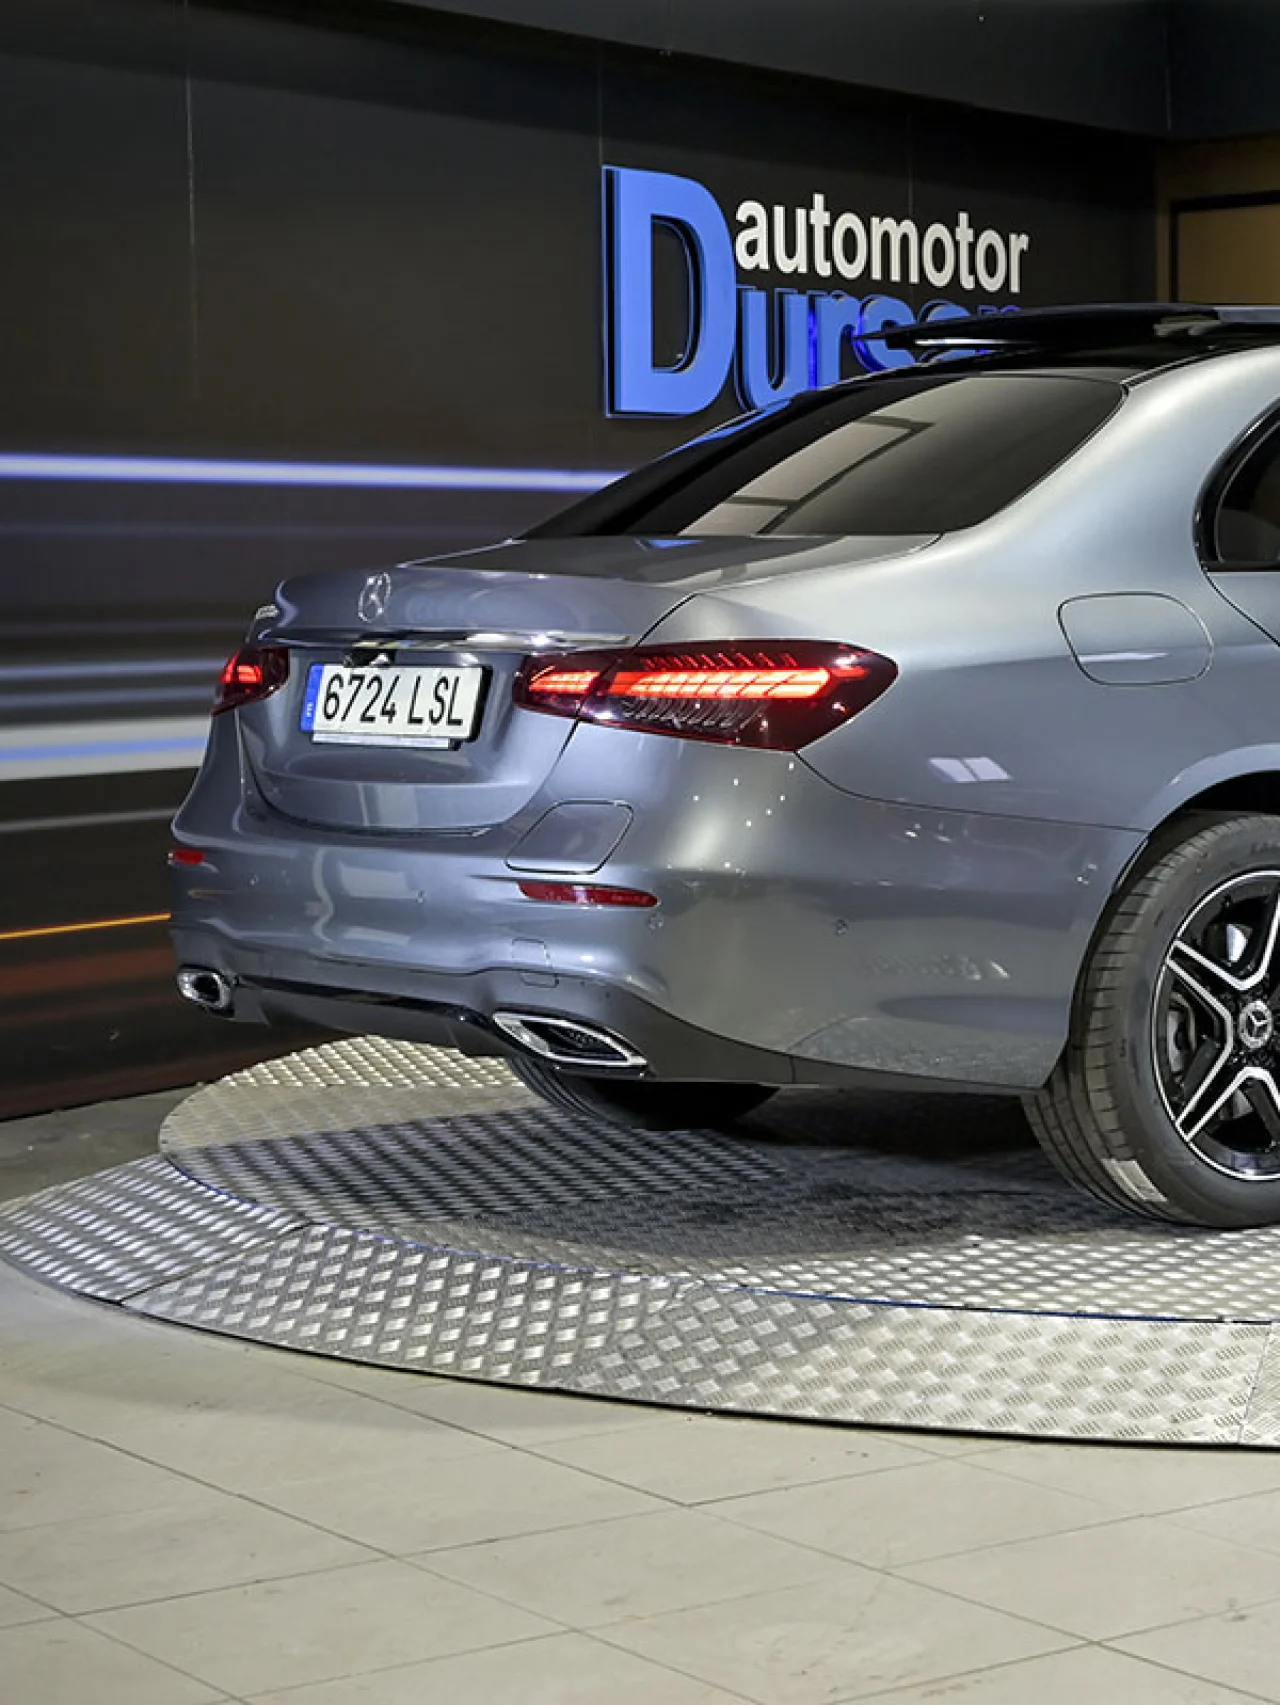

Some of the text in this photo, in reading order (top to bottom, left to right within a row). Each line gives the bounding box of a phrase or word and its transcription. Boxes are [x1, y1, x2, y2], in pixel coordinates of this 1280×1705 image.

[602, 164, 1021, 418] Durs
[735, 193, 1029, 293] automotor
[323, 673, 464, 727] 6724 LSL
